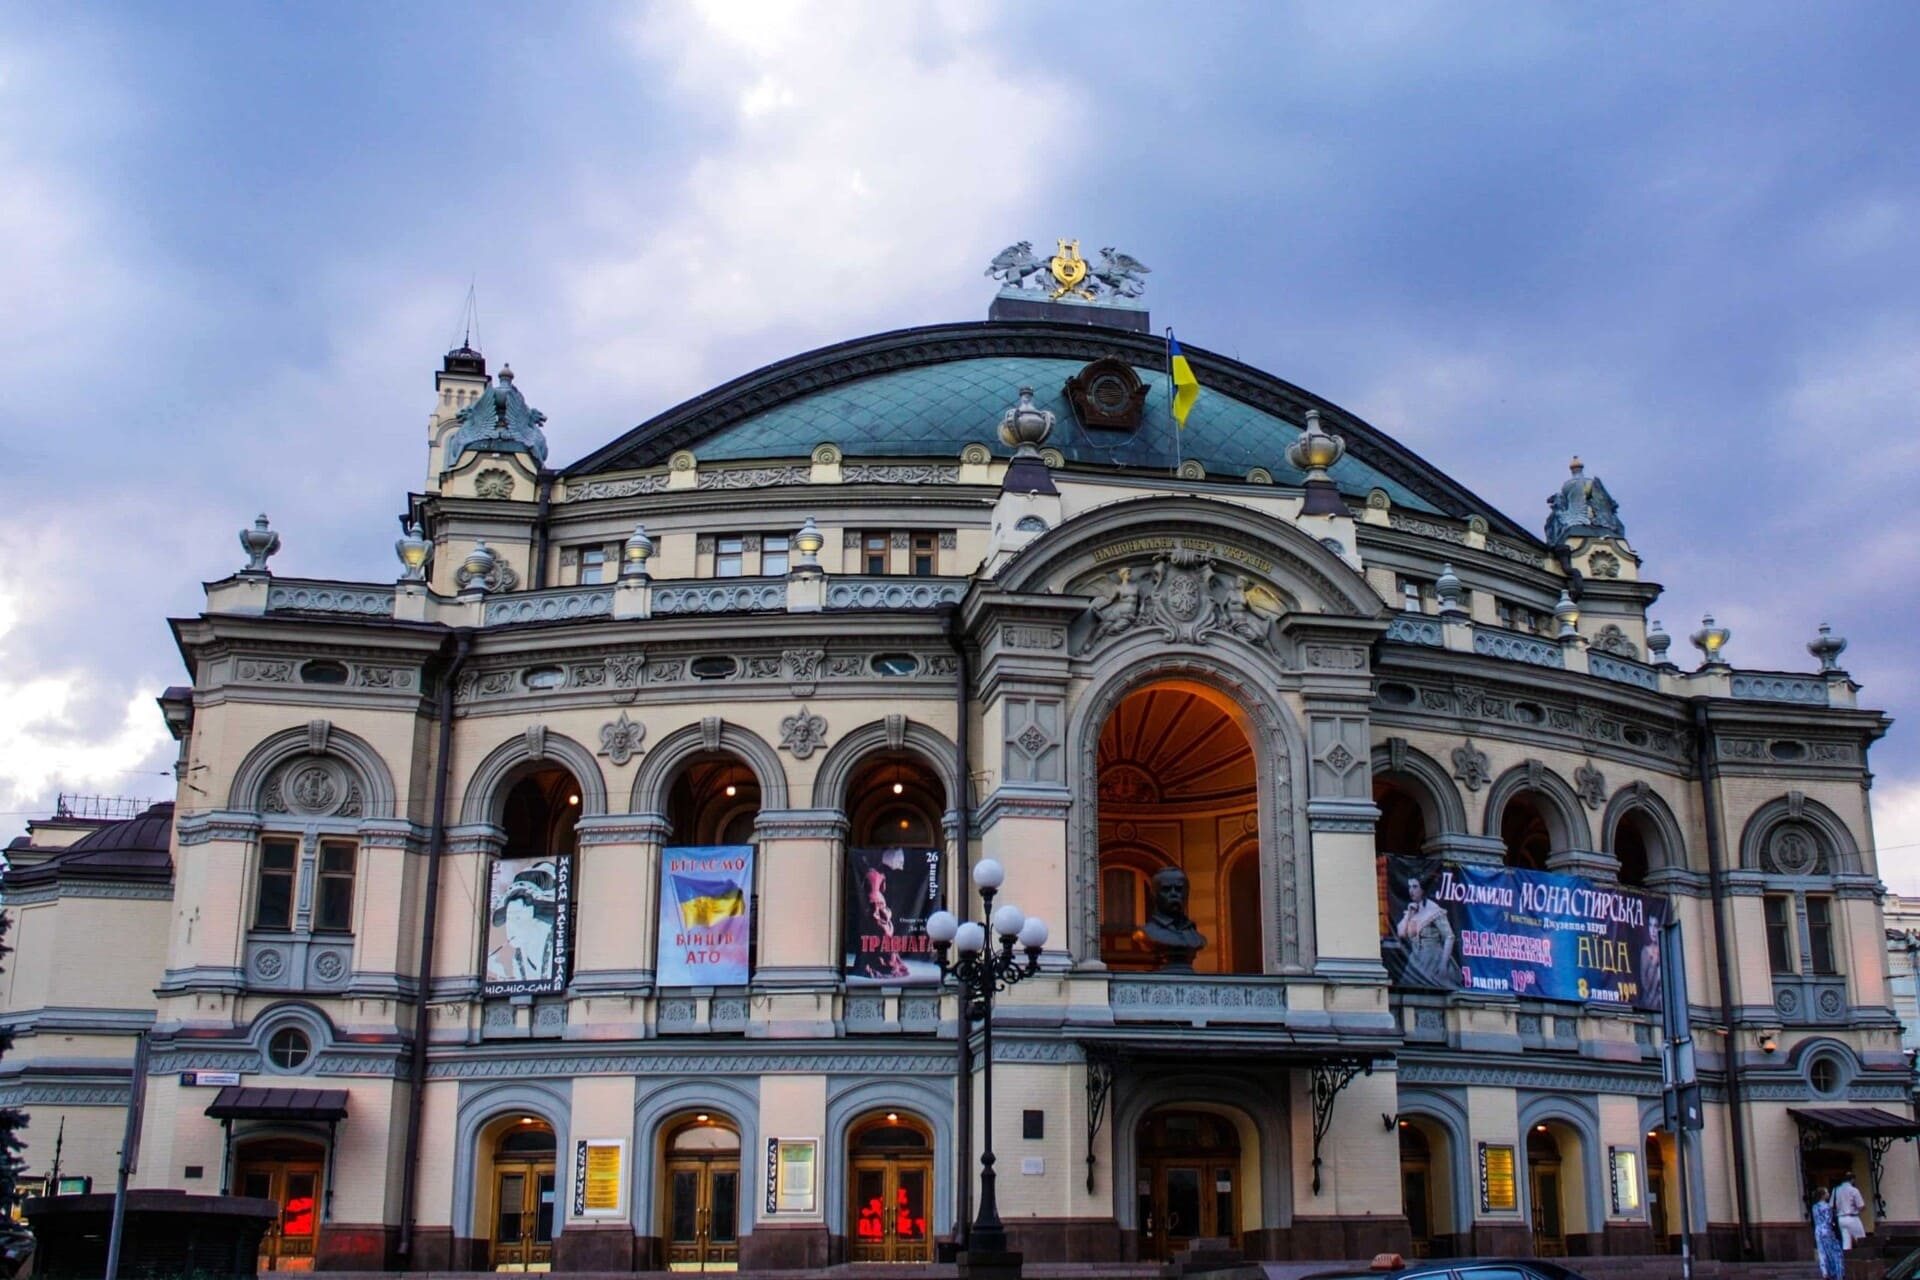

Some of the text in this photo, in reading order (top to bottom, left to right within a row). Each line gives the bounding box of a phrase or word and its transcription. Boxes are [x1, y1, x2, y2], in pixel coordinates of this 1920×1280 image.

[671, 858, 745, 872] ВІТАЄМО
[926, 852, 938, 862] 26
[558, 857, 569, 900] МАДАМ
[1435, 872, 1644, 928] Людмила МОНАСТИРСЬКА
[686, 951, 720, 964] АТО
[1577, 934, 1632, 974] АЇДА
[1472, 976, 1508, 990] липня
[1578, 978, 1589, 999] 8
[1591, 988, 1619, 1002] липня
